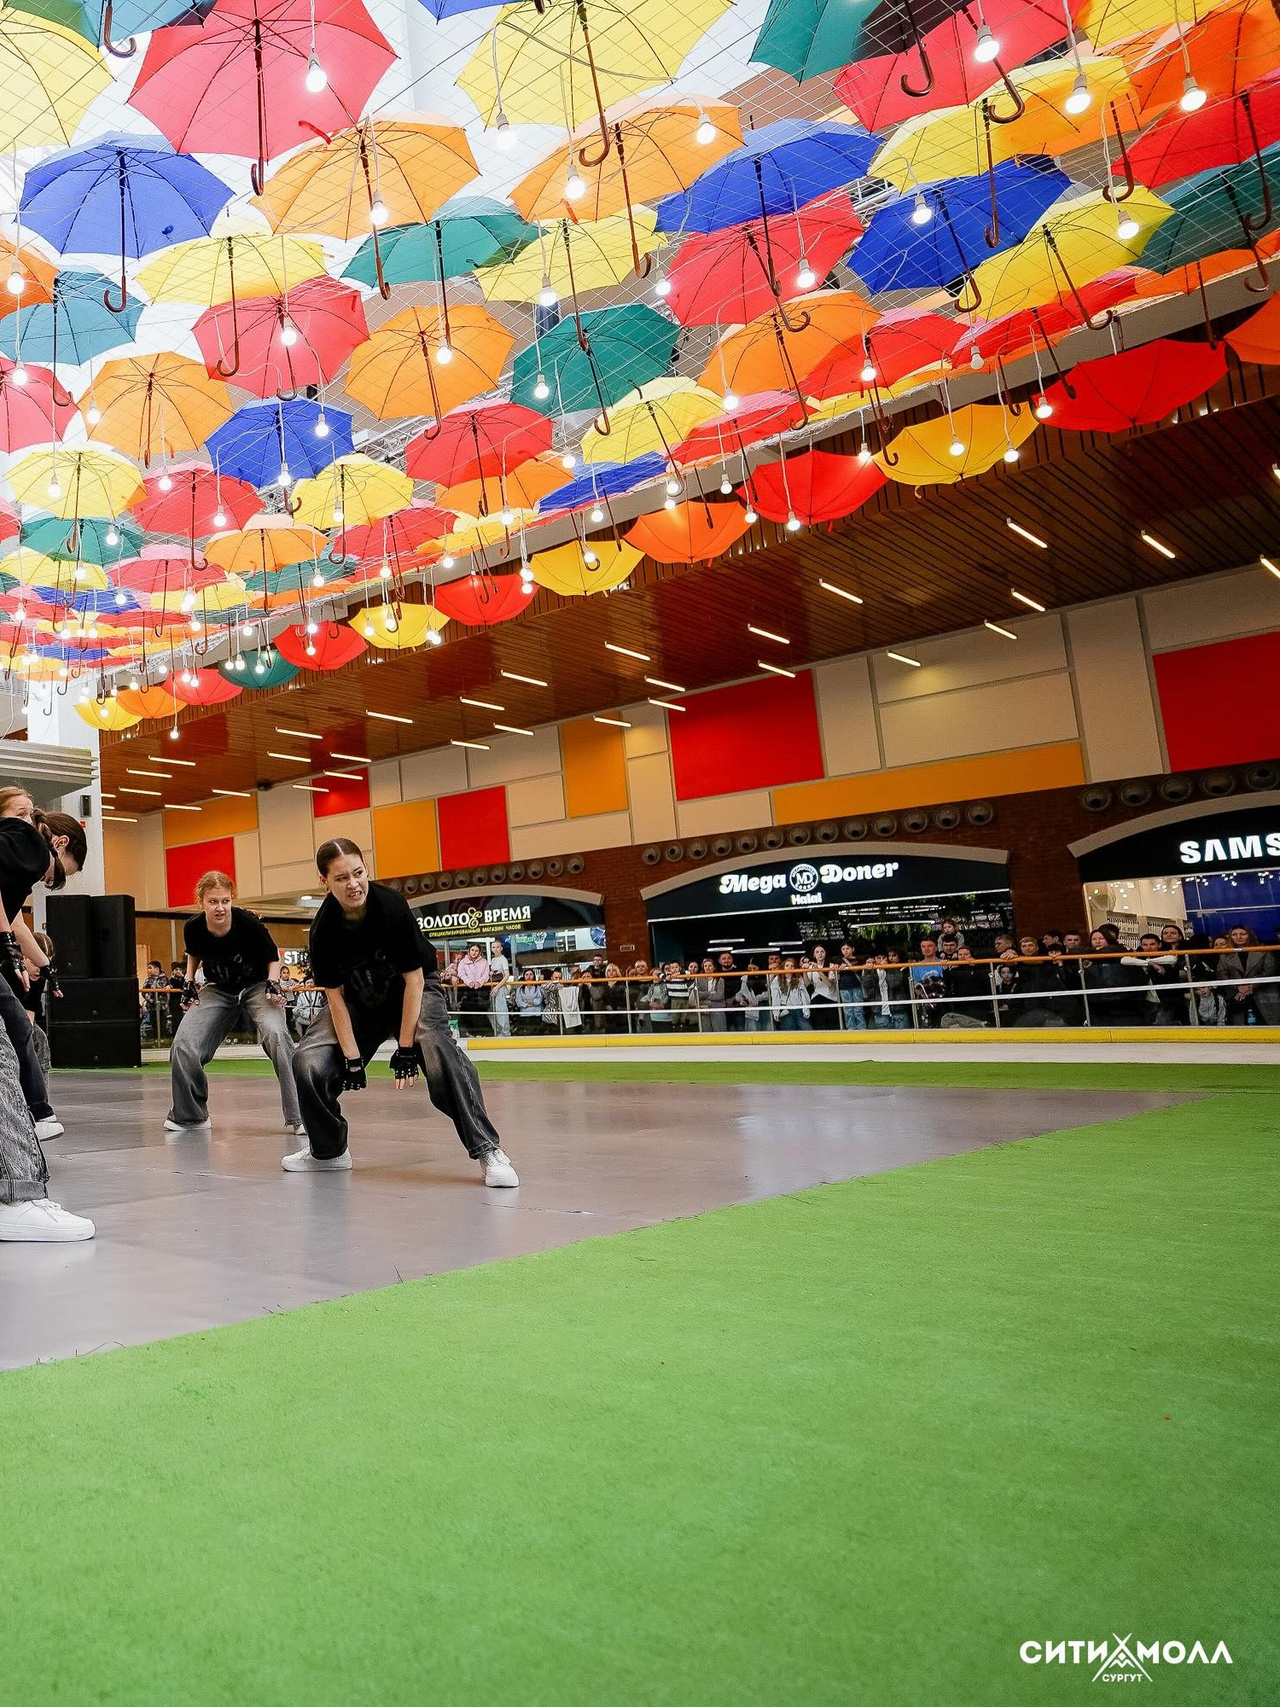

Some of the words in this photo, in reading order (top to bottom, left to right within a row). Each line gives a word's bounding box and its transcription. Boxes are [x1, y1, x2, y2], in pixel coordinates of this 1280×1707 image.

[719, 873, 787, 894] Mega
[820, 862, 899, 884] Doner
[790, 892, 823, 905] Halal
[484, 905, 531, 923] ВРЕМЯ
[481, 925, 504, 933] МАГАЗИН
